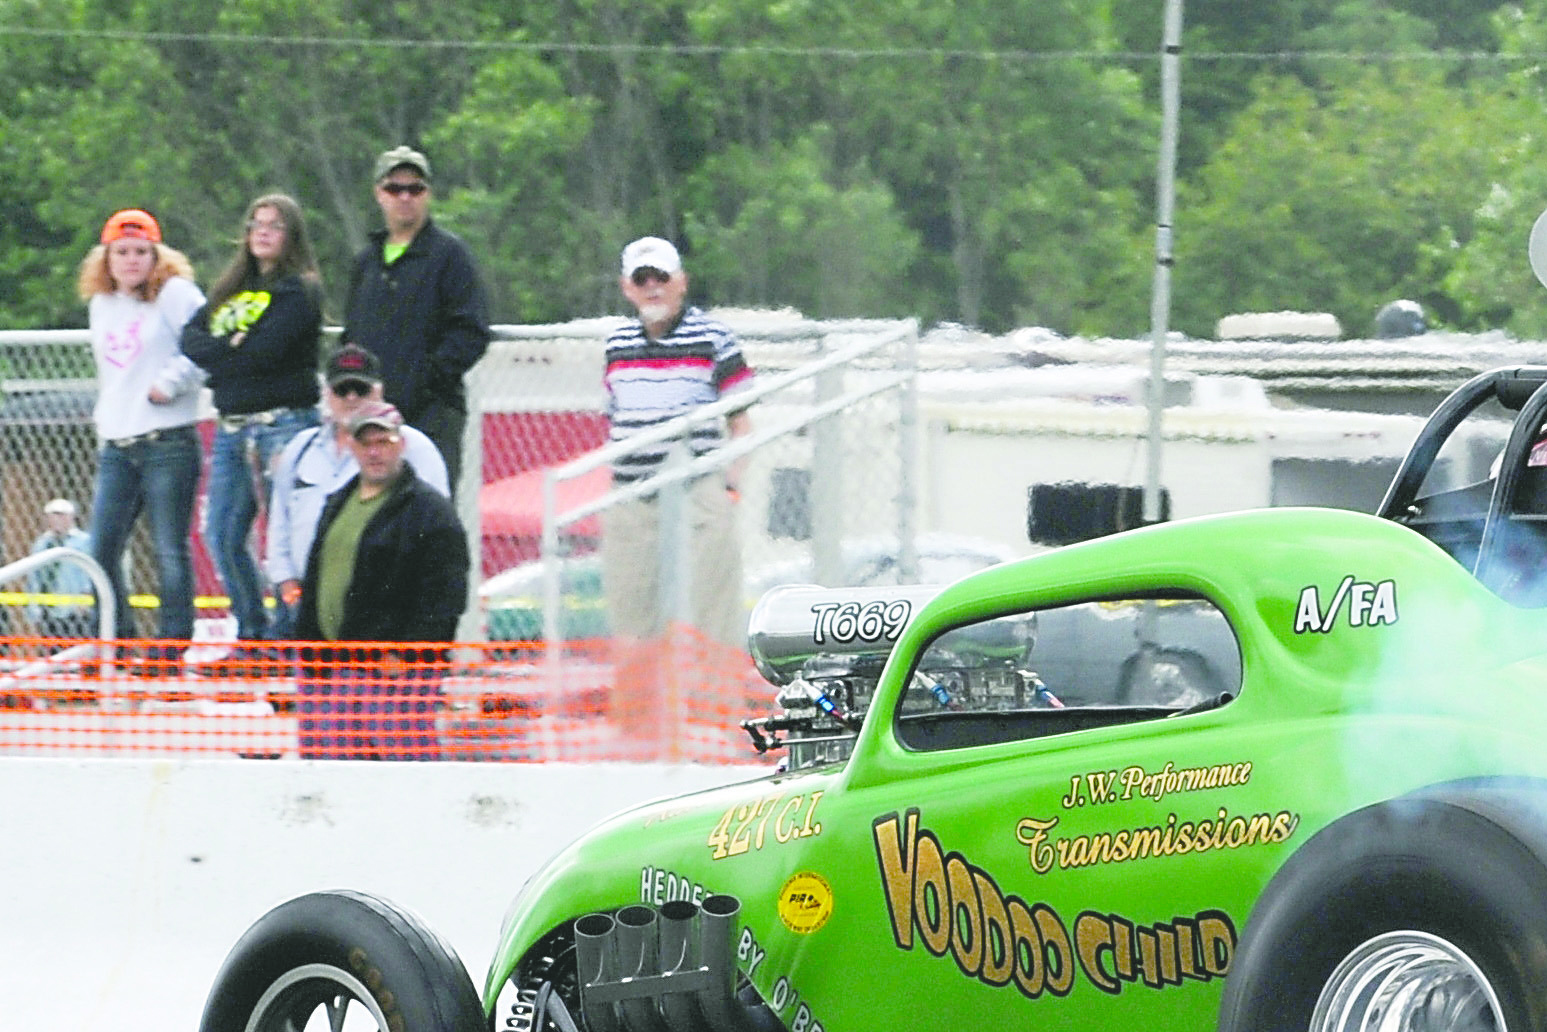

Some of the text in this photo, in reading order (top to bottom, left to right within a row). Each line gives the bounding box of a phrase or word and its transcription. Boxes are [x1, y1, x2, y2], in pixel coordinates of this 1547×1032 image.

[811, 600, 912, 644] T669
[1294, 575, 1399, 634] A/FA
[1063, 761, 1253, 809] J.W. Performance
[707, 791, 788, 861] 427
[1015, 807, 1300, 874] Transmissions
[640, 865, 713, 907] HEDDE
[737, 926, 765, 976] BY
[873, 807, 1076, 999] VOODOO
